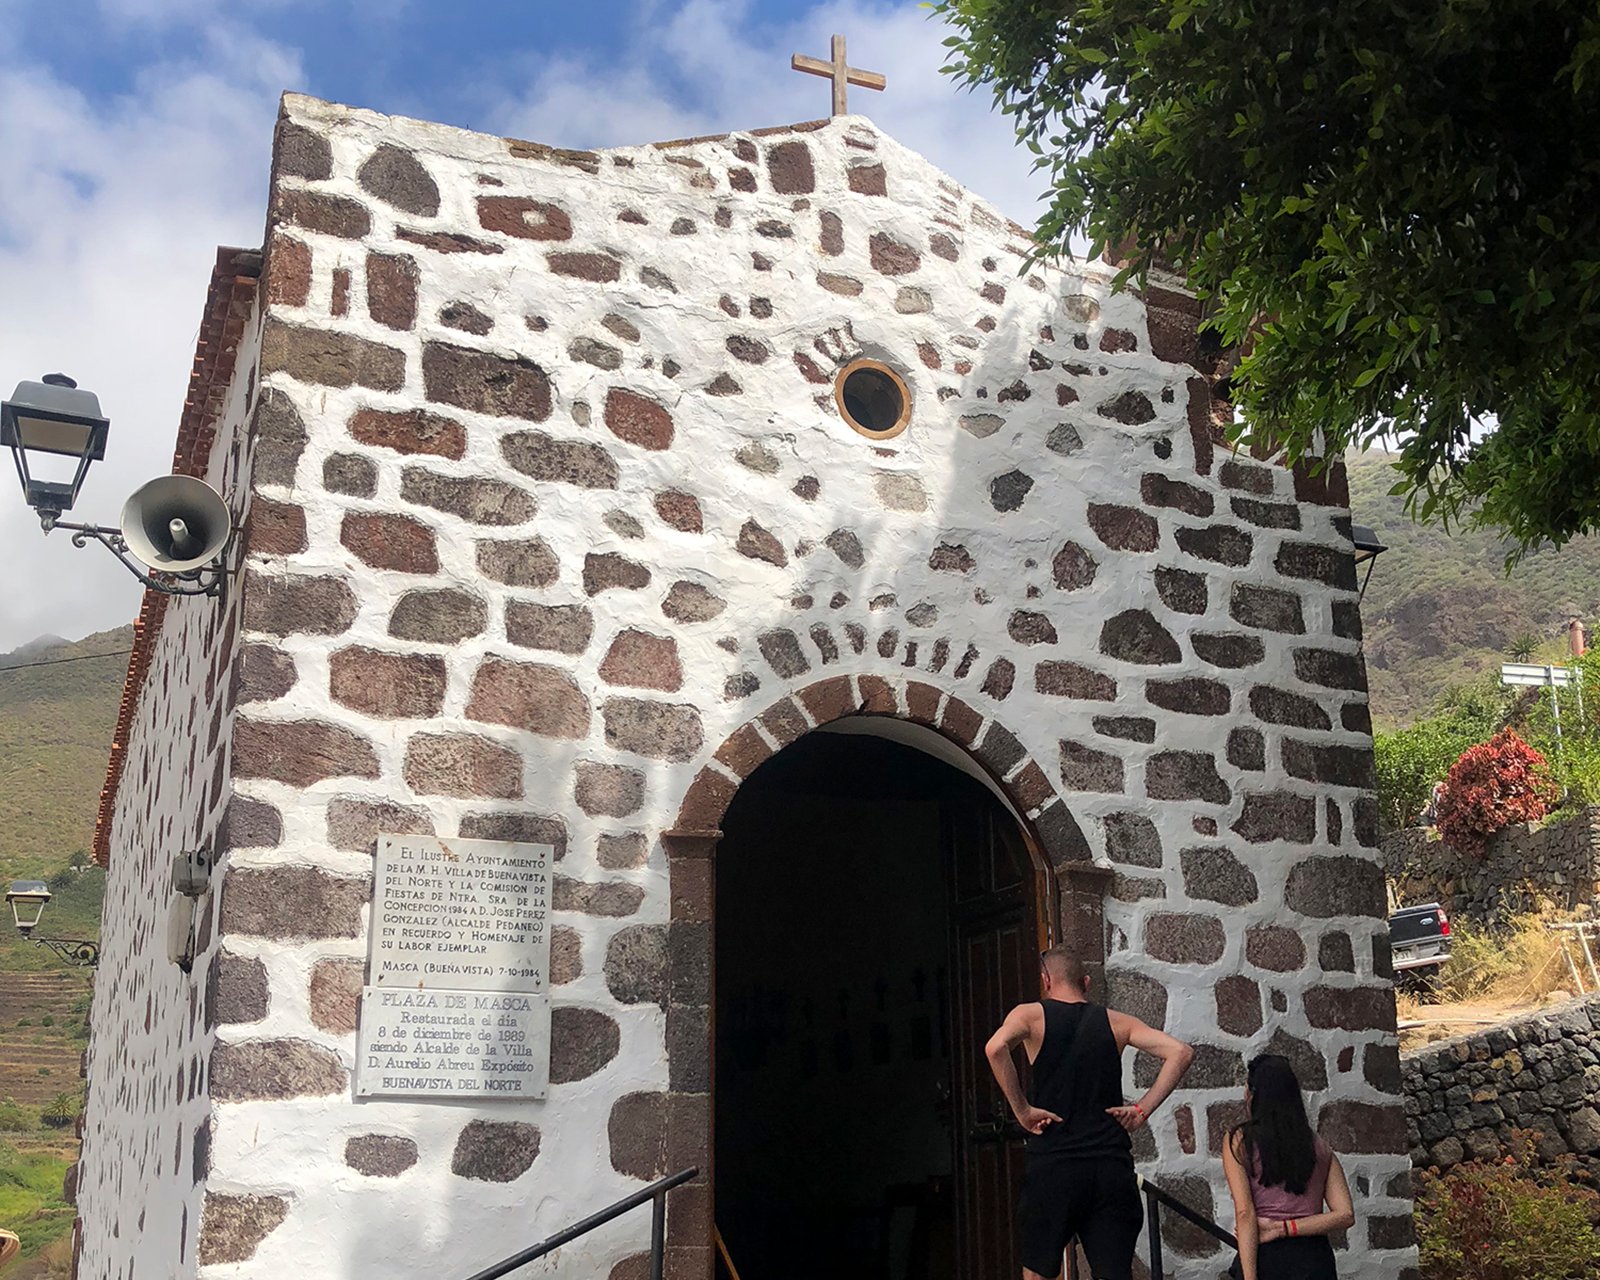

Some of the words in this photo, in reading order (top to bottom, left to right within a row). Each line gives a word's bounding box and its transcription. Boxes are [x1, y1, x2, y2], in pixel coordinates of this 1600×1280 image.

[401, 847, 414, 860] EL
[466, 852, 546, 868] AYUNTAMIENTO
[387, 864, 398, 873] DE
[400, 865, 413, 874] LA
[445, 866, 472, 877] VILLA
[475, 870, 486, 878] DE
[488, 870, 546, 882] BUENAVISTA
[386, 876, 402, 885] DEL
[409, 877, 442, 888] NORTE
[449, 880, 455, 889] Y
[461, 882, 473, 890] LA
[480, 882, 527, 893] COMISION
[534, 886, 546, 894] DE
[385, 888, 424, 899] FIESTAS
[432, 892, 442, 900] DE
[518, 898, 528, 906] DE
[534, 899, 546, 907] LA
[384, 900, 446, 912] CONCEPCION
[448, 906, 467, 914] 1984
[480, 906, 488, 916] D.
[490, 907, 514, 917] JOSE
[516, 908, 546, 920] PEREZ
[384, 914, 438, 926] GONZALEZ
[442, 916, 490, 928] (ALCALDE
[496, 920, 544, 932] PEDANEO)
[402, 928, 452, 939] RECUERDO
[458, 932, 465, 940] Y
[472, 931, 525, 943] HOMENAJE
[532, 936, 544, 944] DE
[399, 942, 432, 950] LABOR
[438, 943, 486, 954] EJEMPLAR
[382, 961, 418, 972] MASCA
[499, 968, 540, 977] 7-10-1984
[382, 993, 438, 1008] PLAZA
[445, 995, 466, 1008] DE
[474, 996, 532, 1011] MASCA
[400, 1012, 475, 1026] Restaurada
[482, 1015, 492, 1026] el
[378, 1027, 386, 1037] 8
[392, 1027, 406, 1038] de
[413, 1028, 471, 1040] diciembre
[478, 1030, 491, 1040] de
[498, 1030, 526, 1042] 1989
[370, 1040, 408, 1052] siendo
[414, 1042, 459, 1055] Alcalde
[466, 1044, 480, 1056] de
[486, 1044, 496, 1056] la
[503, 1044, 532, 1057] Villa
[368, 1056, 380, 1069] D.
[385, 1057, 431, 1070] Aurelio
[436, 1058, 474, 1070] Abreu
[382, 1078, 452, 1089] BUENAVISTA
[458, 1080, 480, 1090] DEL
[484, 1080, 522, 1092] NORTE
